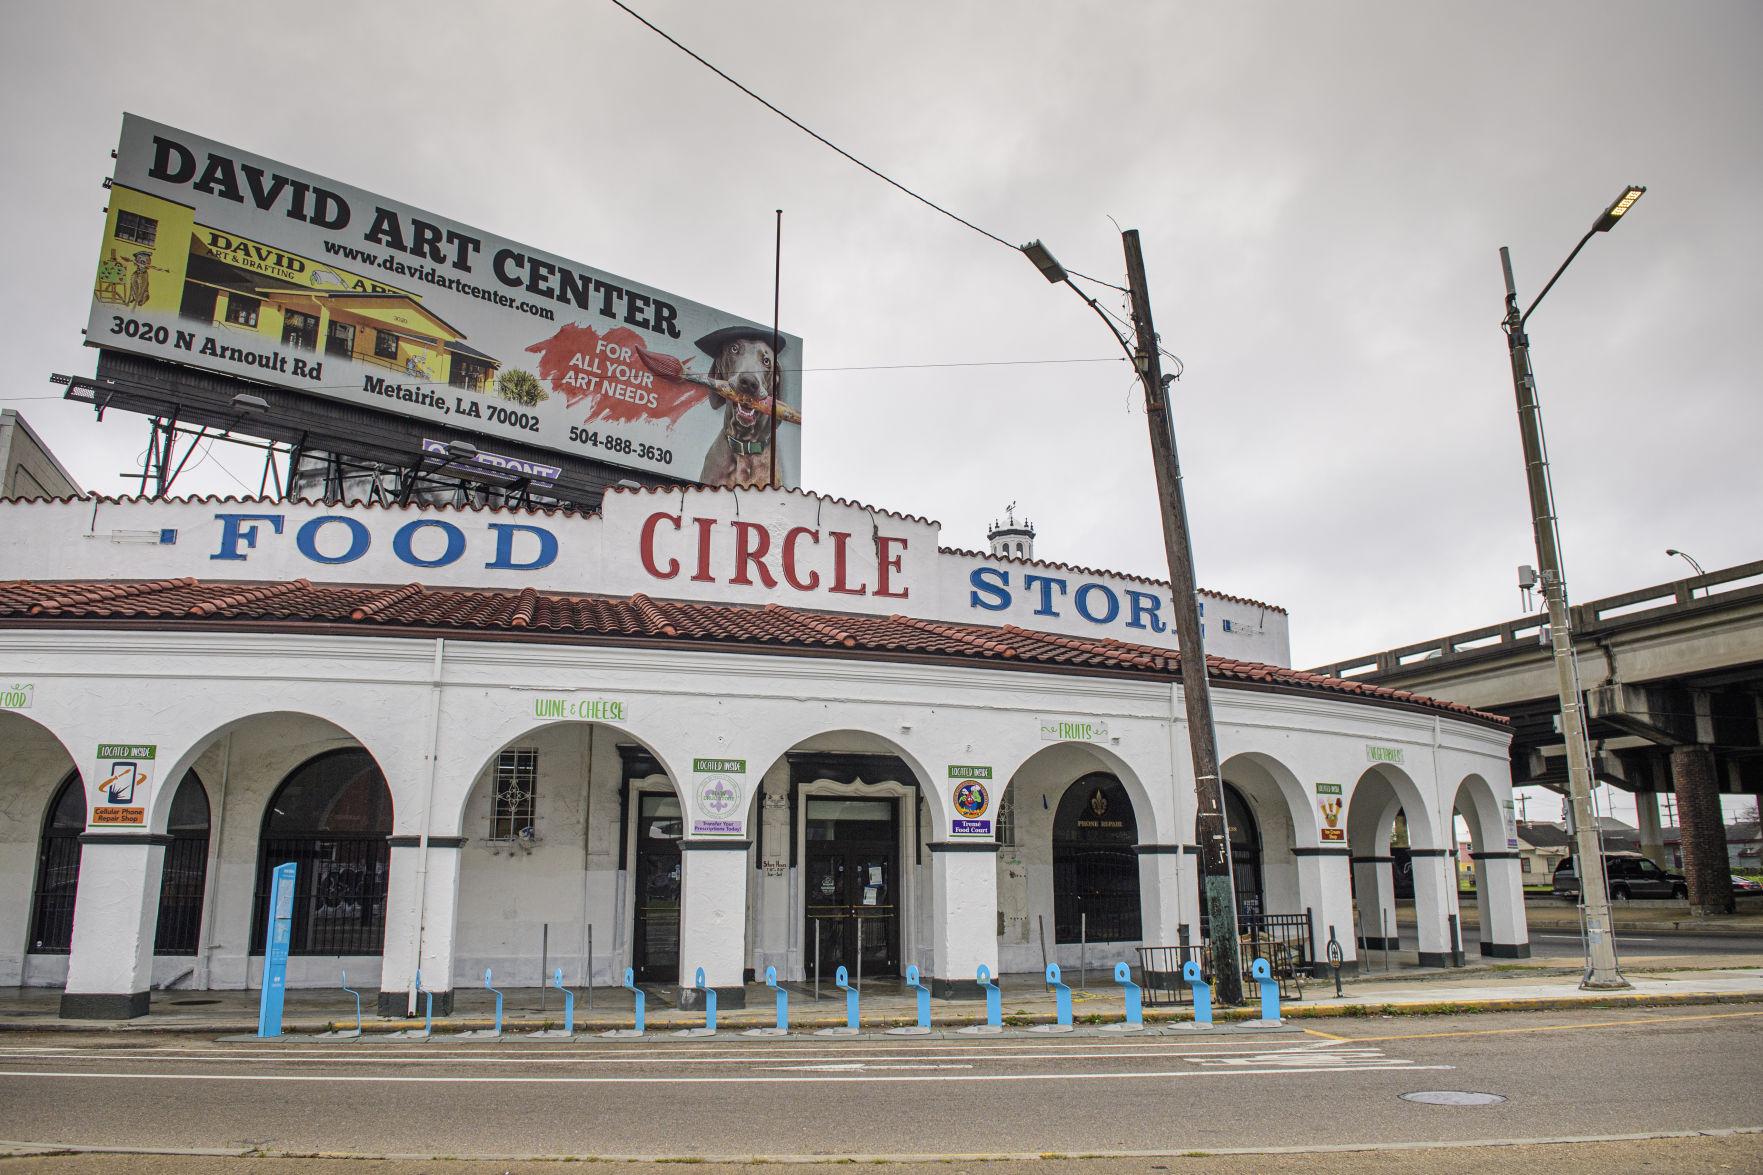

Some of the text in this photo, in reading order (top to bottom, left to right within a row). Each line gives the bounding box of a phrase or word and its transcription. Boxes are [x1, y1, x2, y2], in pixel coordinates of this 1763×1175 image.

[148, 135, 681, 340] DAVID ART CENTER
[207, 232, 306, 274] DAVID
[206, 249, 295, 280] ART & DRAFTING
[323, 240, 555, 321] www.davidartcenter.com
[110, 315, 323, 381] 3020 N Arnoult Rd
[596, 339, 632, 362] FOR
[569, 352, 654, 388] ALL YOUR
[363, 374, 540, 432] Metairie, LA 70002
[562, 370, 659, 409] ART NEEDS
[569, 426, 673, 465] 504-888-3630
[210, 513, 559, 571] FOOD
[640, 511, 909, 599] CIRCLE
[535, 698, 568, 718] WINE
[578, 700, 625, 720] CHEESE
[1059, 722, 1092, 740] FRUITS
[101, 746, 151, 757] LOCATED INSIDE
[697, 761, 741, 771] LOCATED INSIDE
[951, 767, 988, 777] LOCATED INSIDE
[98, 815, 138, 823] Repair Shop
